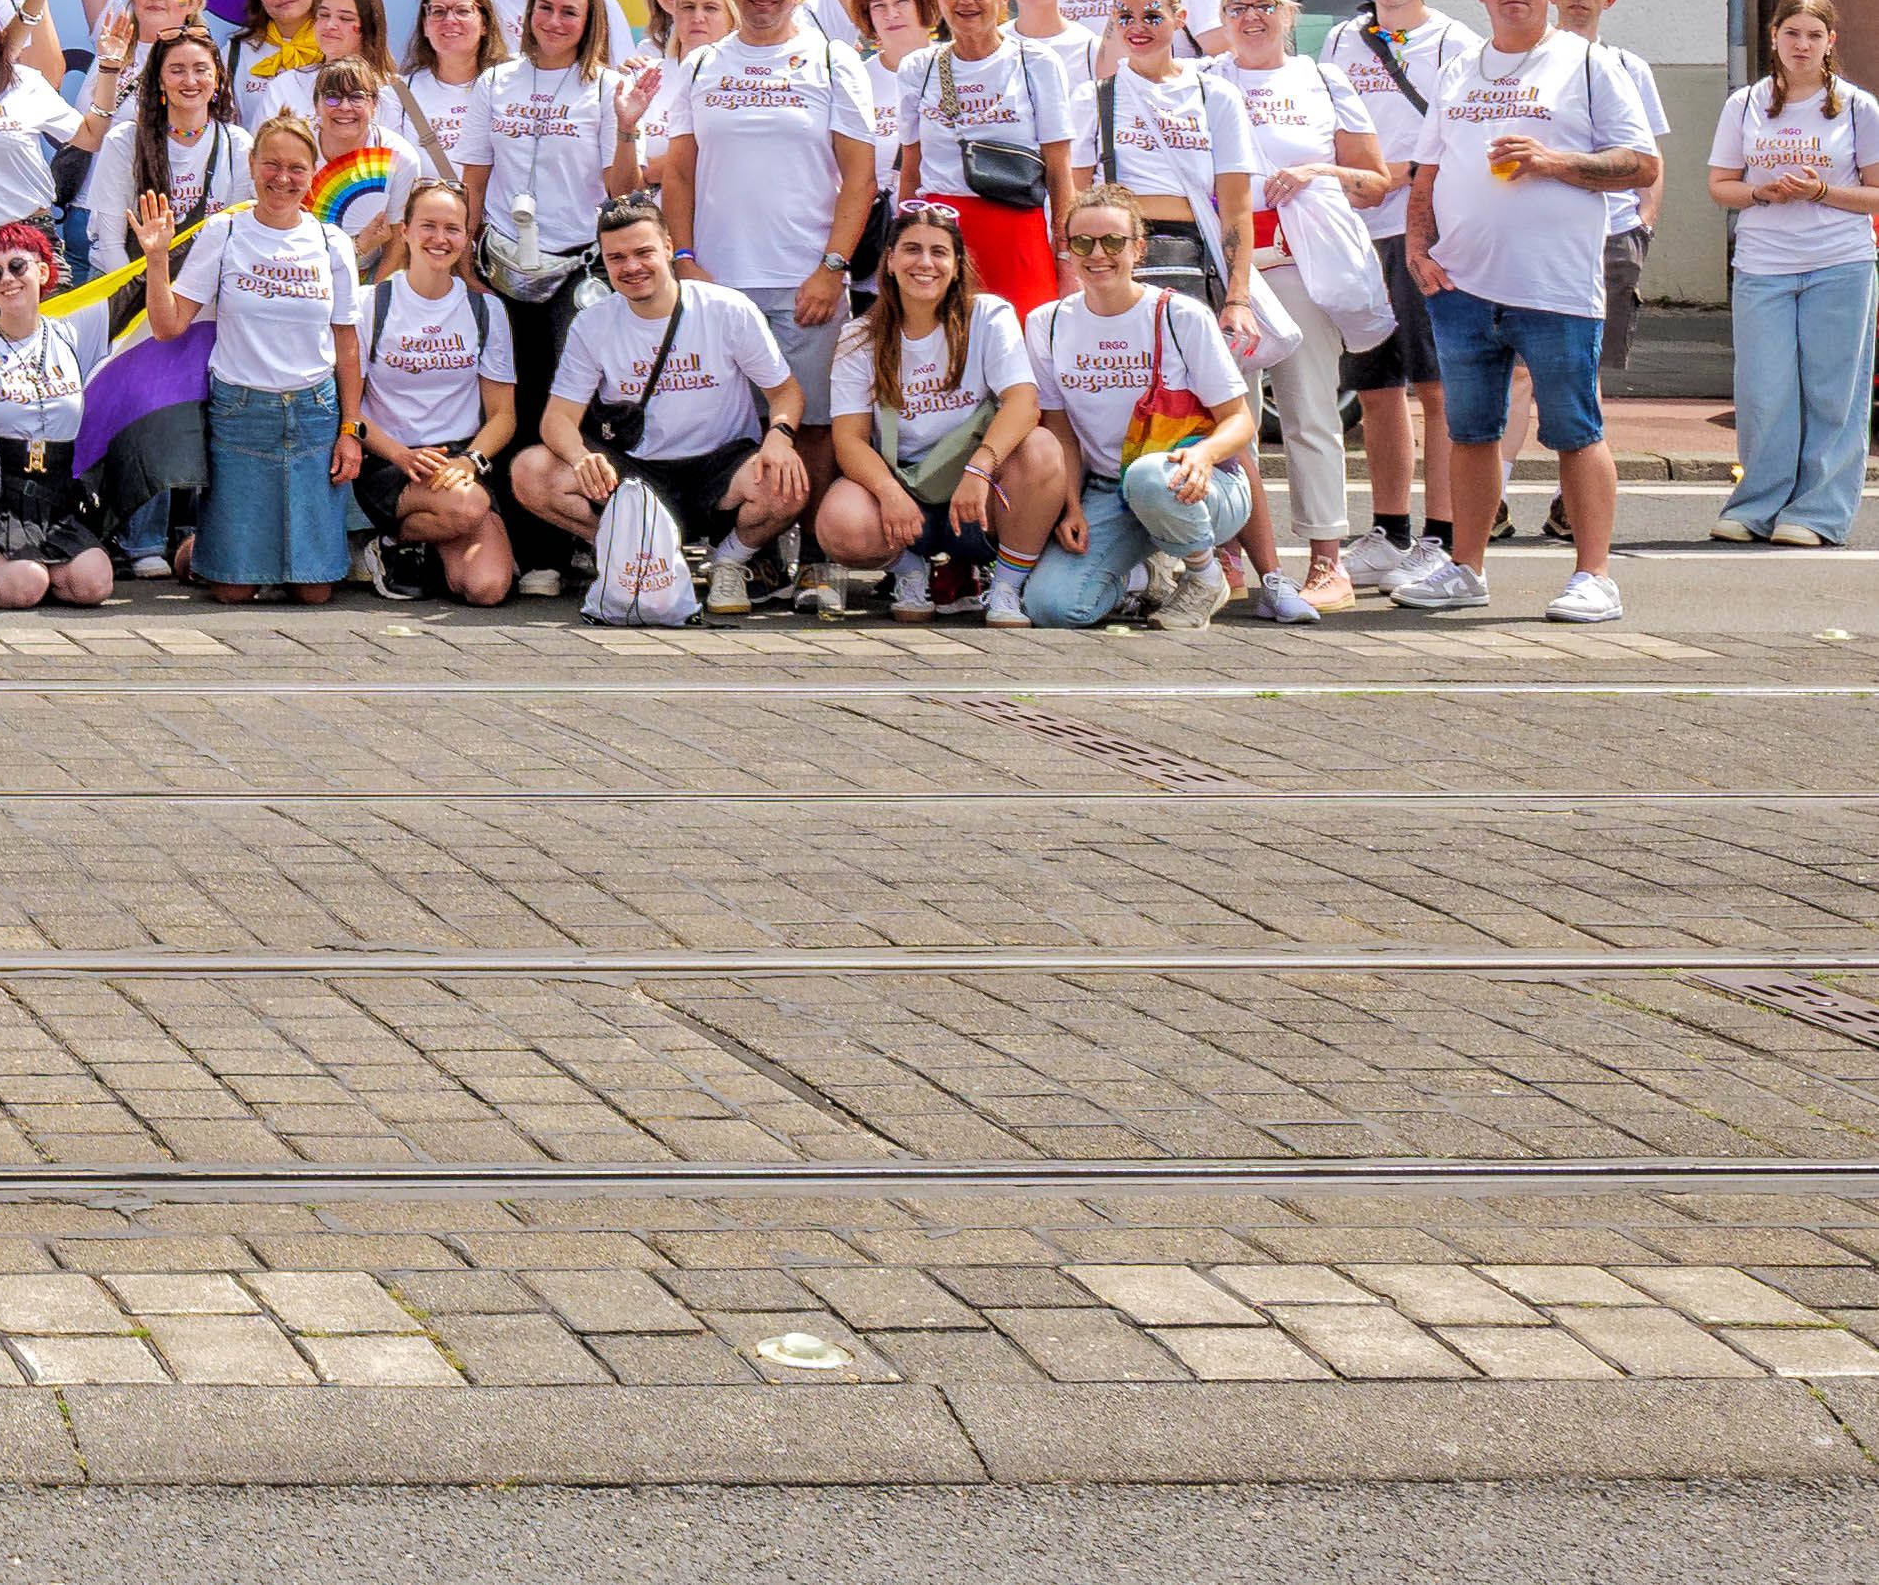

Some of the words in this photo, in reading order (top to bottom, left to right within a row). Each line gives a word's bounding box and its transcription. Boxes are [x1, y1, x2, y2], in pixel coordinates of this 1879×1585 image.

[745, 67, 771, 76] ERGO
[958, 84, 983, 93] ERGO
[1099, 340, 1128, 351] ERGO
